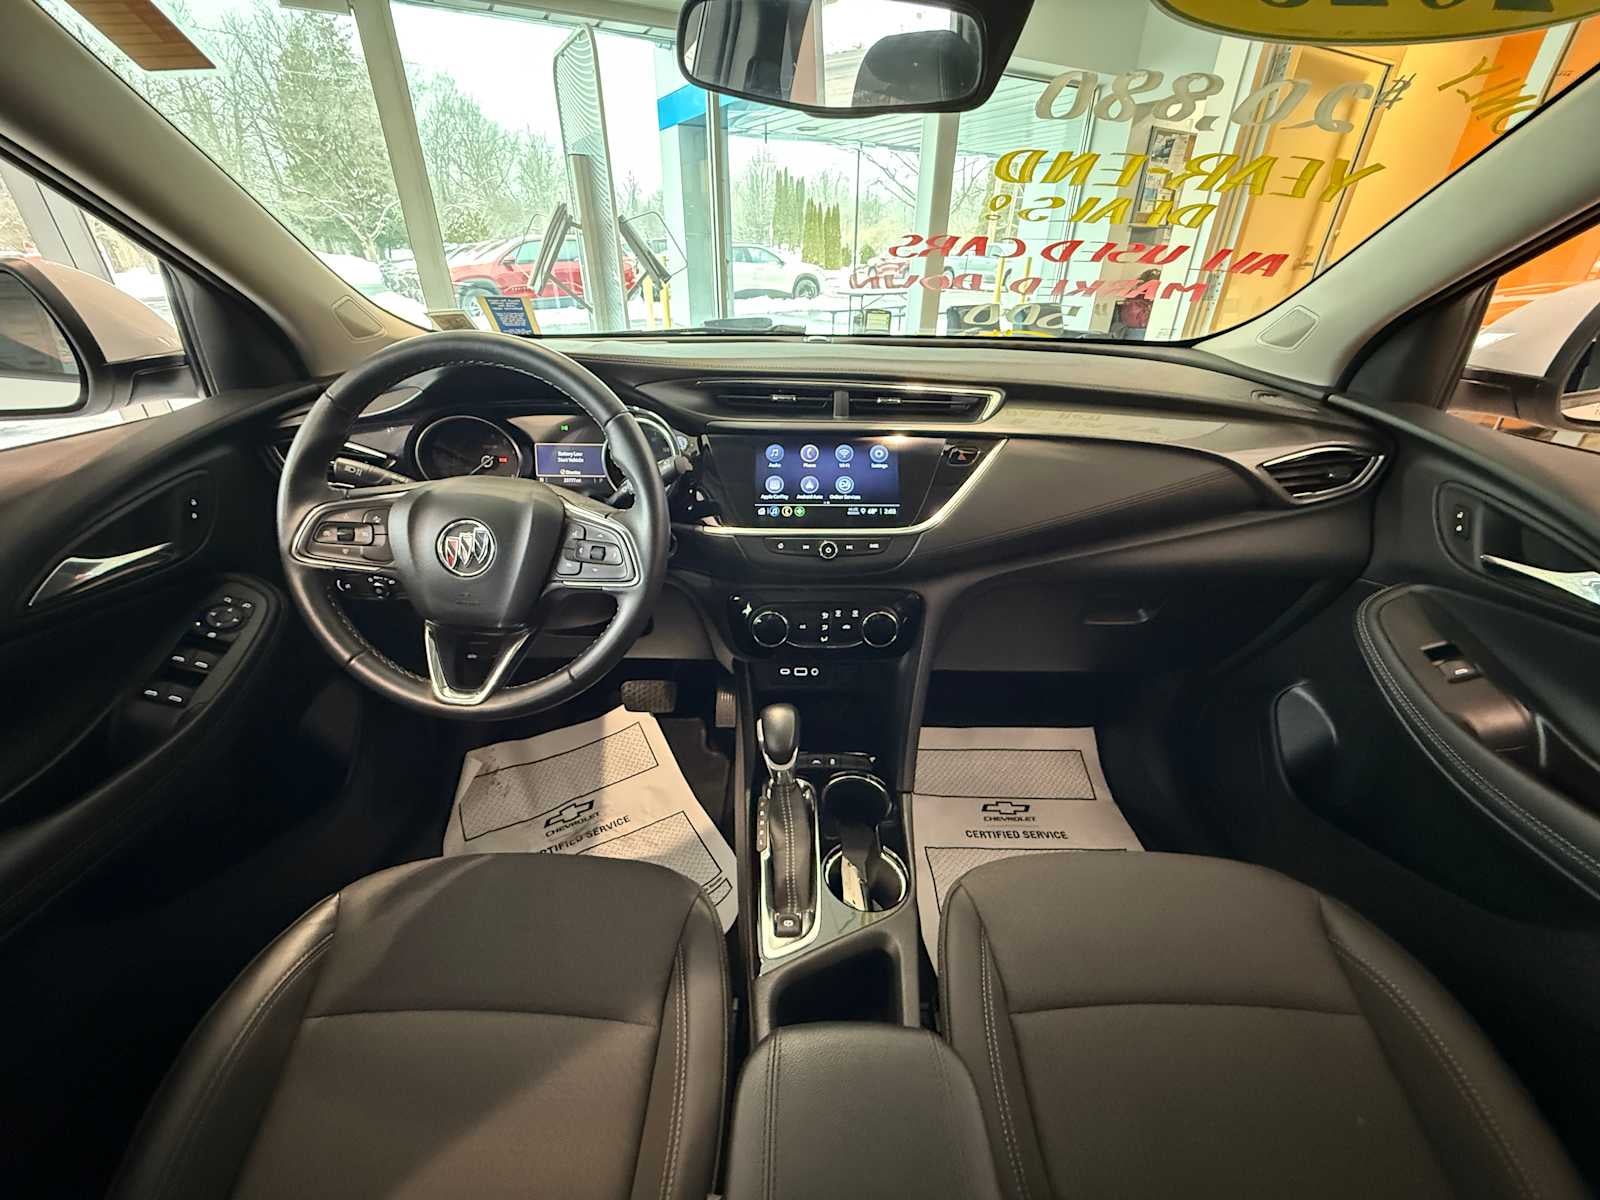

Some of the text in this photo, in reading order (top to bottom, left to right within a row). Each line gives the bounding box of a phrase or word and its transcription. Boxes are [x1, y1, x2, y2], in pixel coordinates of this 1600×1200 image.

[585, 814, 632, 838] SERVICE
[965, 829, 1069, 840] CERTIFIED SERVICE
